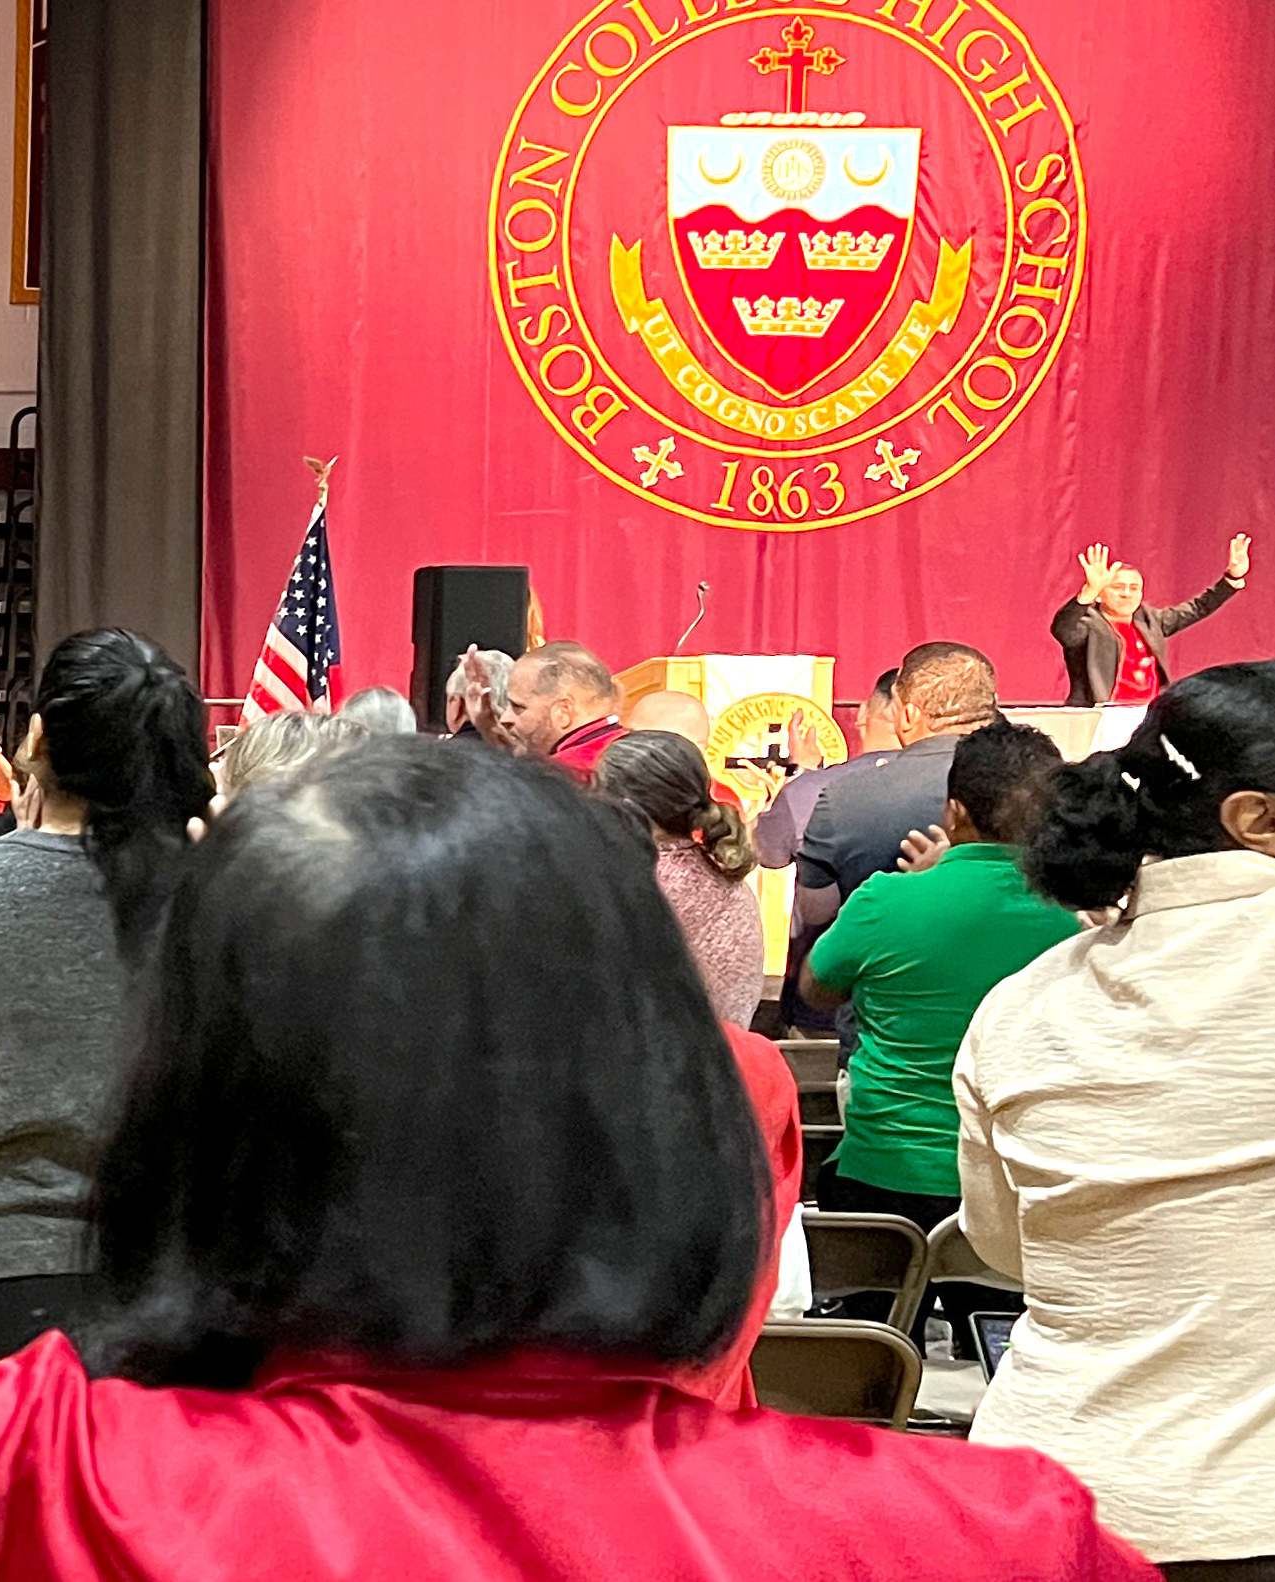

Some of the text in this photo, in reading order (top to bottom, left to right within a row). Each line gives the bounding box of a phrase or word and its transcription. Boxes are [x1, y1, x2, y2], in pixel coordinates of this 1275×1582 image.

[505, 136, 629, 445] BOSTON
[927, 153, 1071, 441] SCHOOL
[643, 312, 680, 357] UT
[897, 317, 931, 360] TE
[710, 459, 846, 519] 1863
